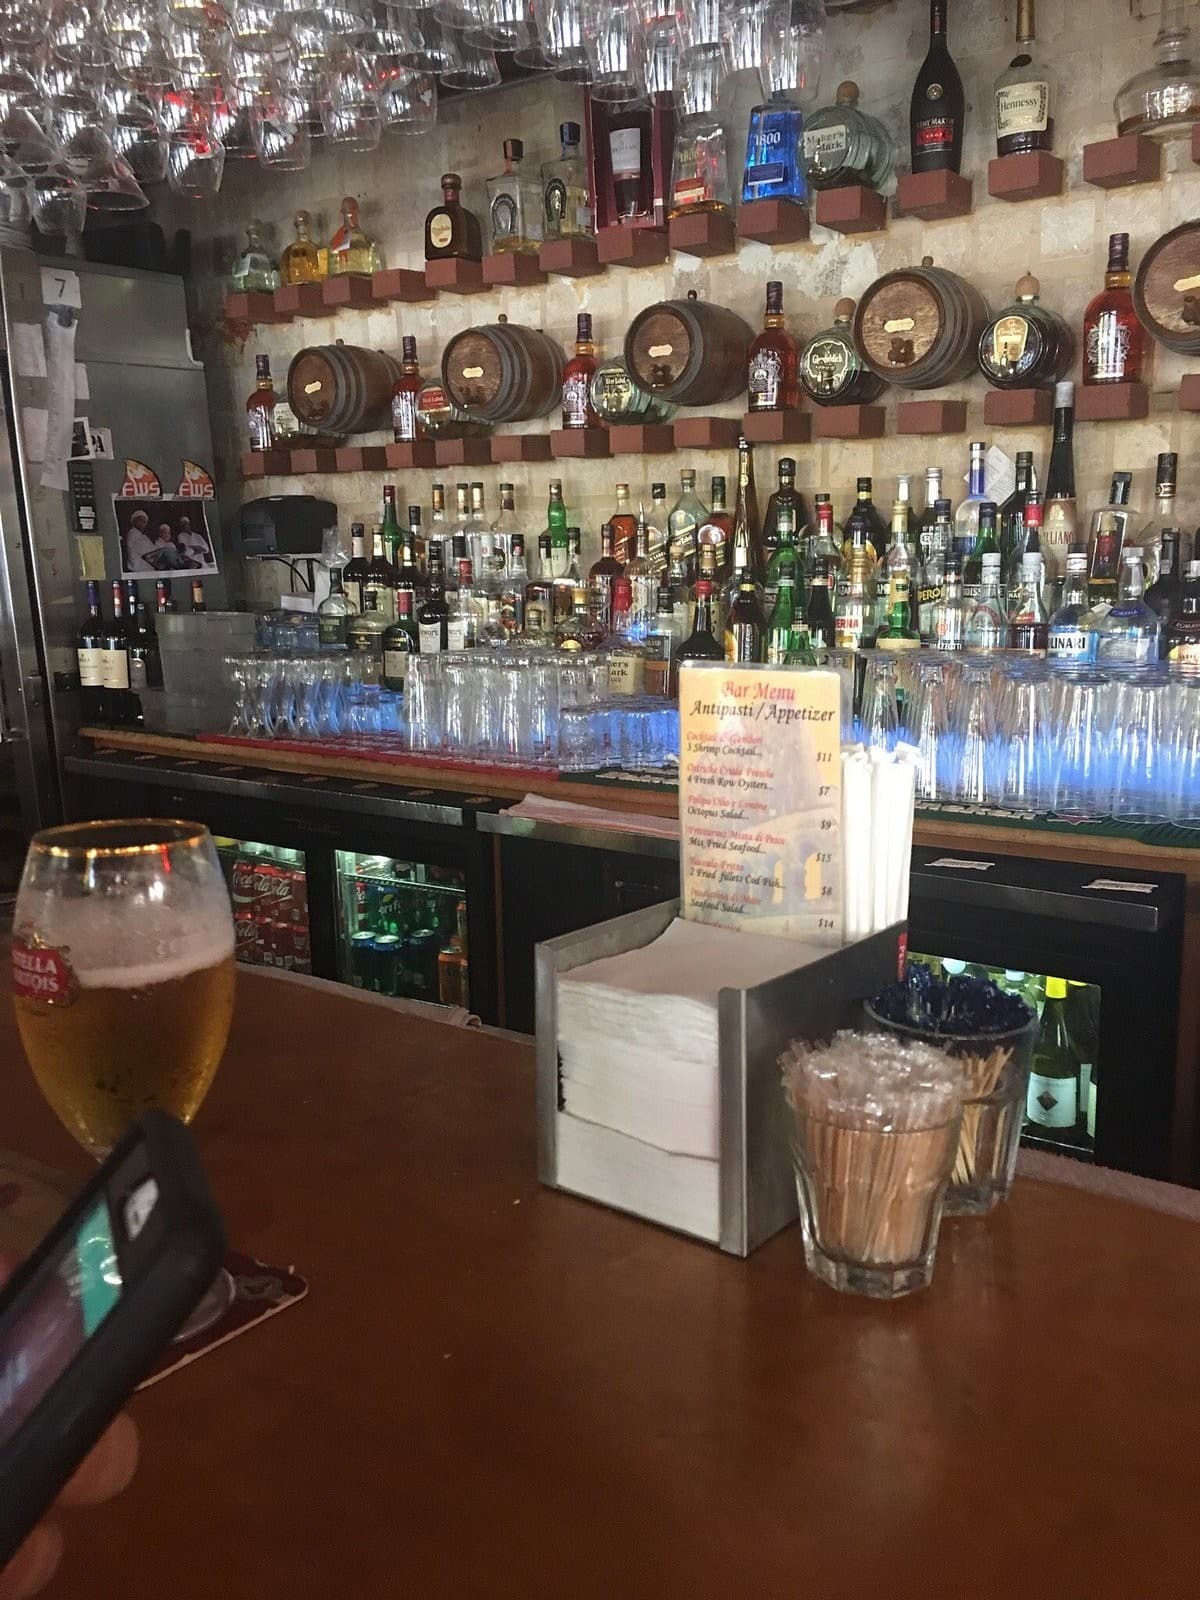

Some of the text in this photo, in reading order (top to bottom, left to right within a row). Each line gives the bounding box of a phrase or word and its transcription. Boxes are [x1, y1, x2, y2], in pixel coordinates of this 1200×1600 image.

[1000, 98, 1038, 112] Hennessy
[755, 132, 781, 146] 1800
[54, 277, 66, 299] 7
[835, 618, 859, 629] ERNA
[611, 669, 628, 677] ark
[722, 680, 796, 701] Bar Menu
[689, 700, 753, 721] Antipasti
[765, 703, 835, 725] Appetizer
[816, 752, 833, 763] $11
[819, 787, 831, 796] $7
[687, 806, 719, 819] Octopus
[821, 820, 832, 830] $9
[816, 852, 832, 863] $15
[696, 868, 716, 879] Fried
[744, 875, 760, 886] Cod
[821, 886, 833, 896] $8
[690, 898, 719, 913] Seafood
[818, 918, 834, 929] $14
